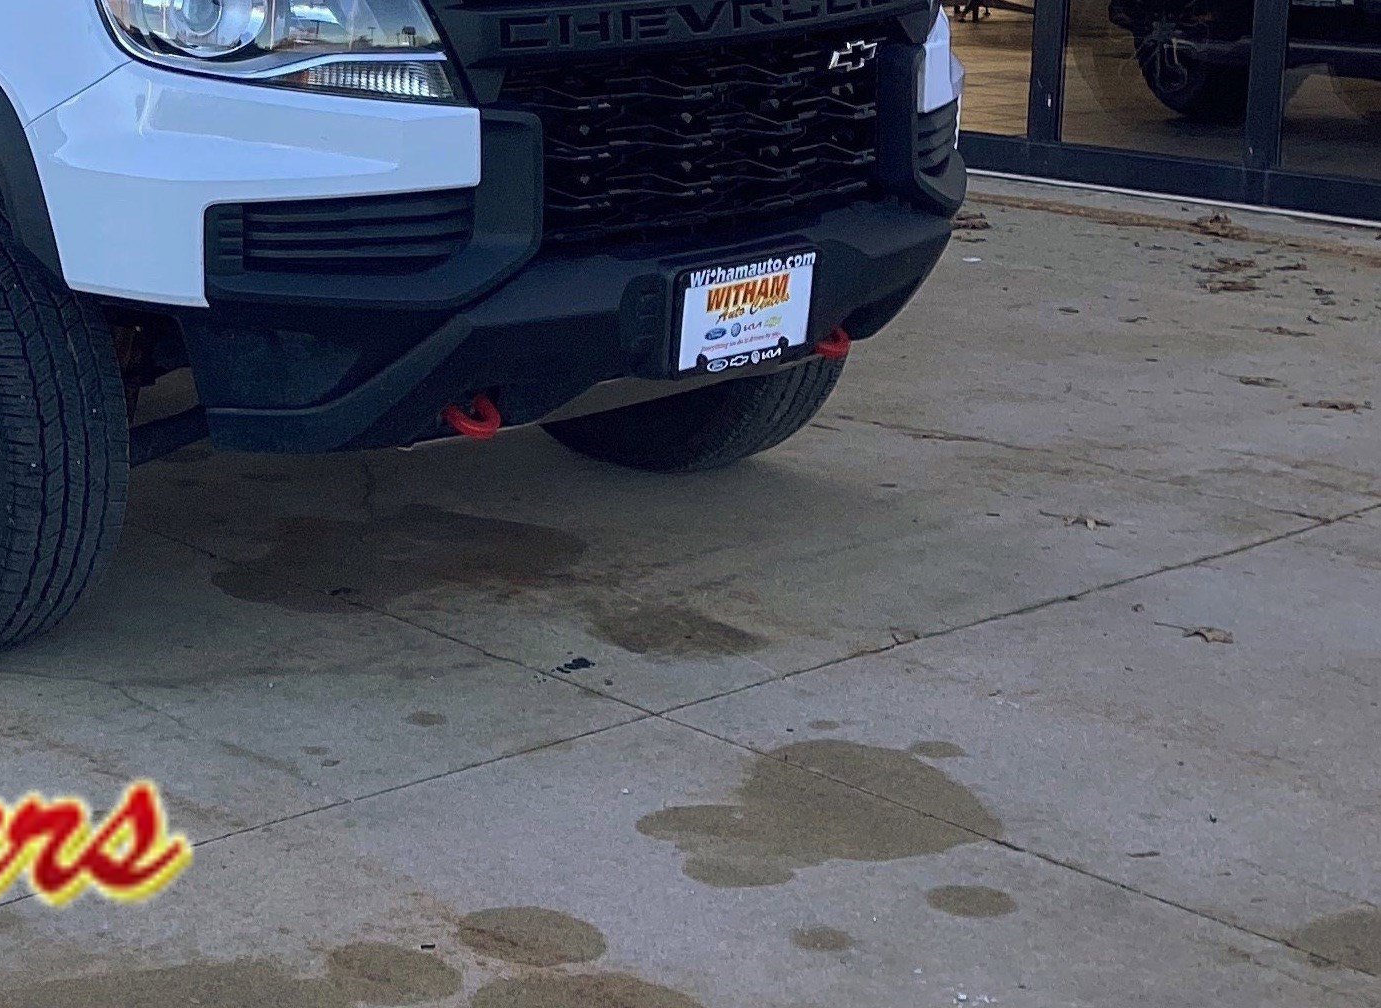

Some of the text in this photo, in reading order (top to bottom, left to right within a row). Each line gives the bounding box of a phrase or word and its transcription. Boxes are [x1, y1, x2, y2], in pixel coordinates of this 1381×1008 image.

[706, 273, 791, 312] WITHAM
[716, 306, 745, 325] Auto
[761, 347, 782, 360] KIA
